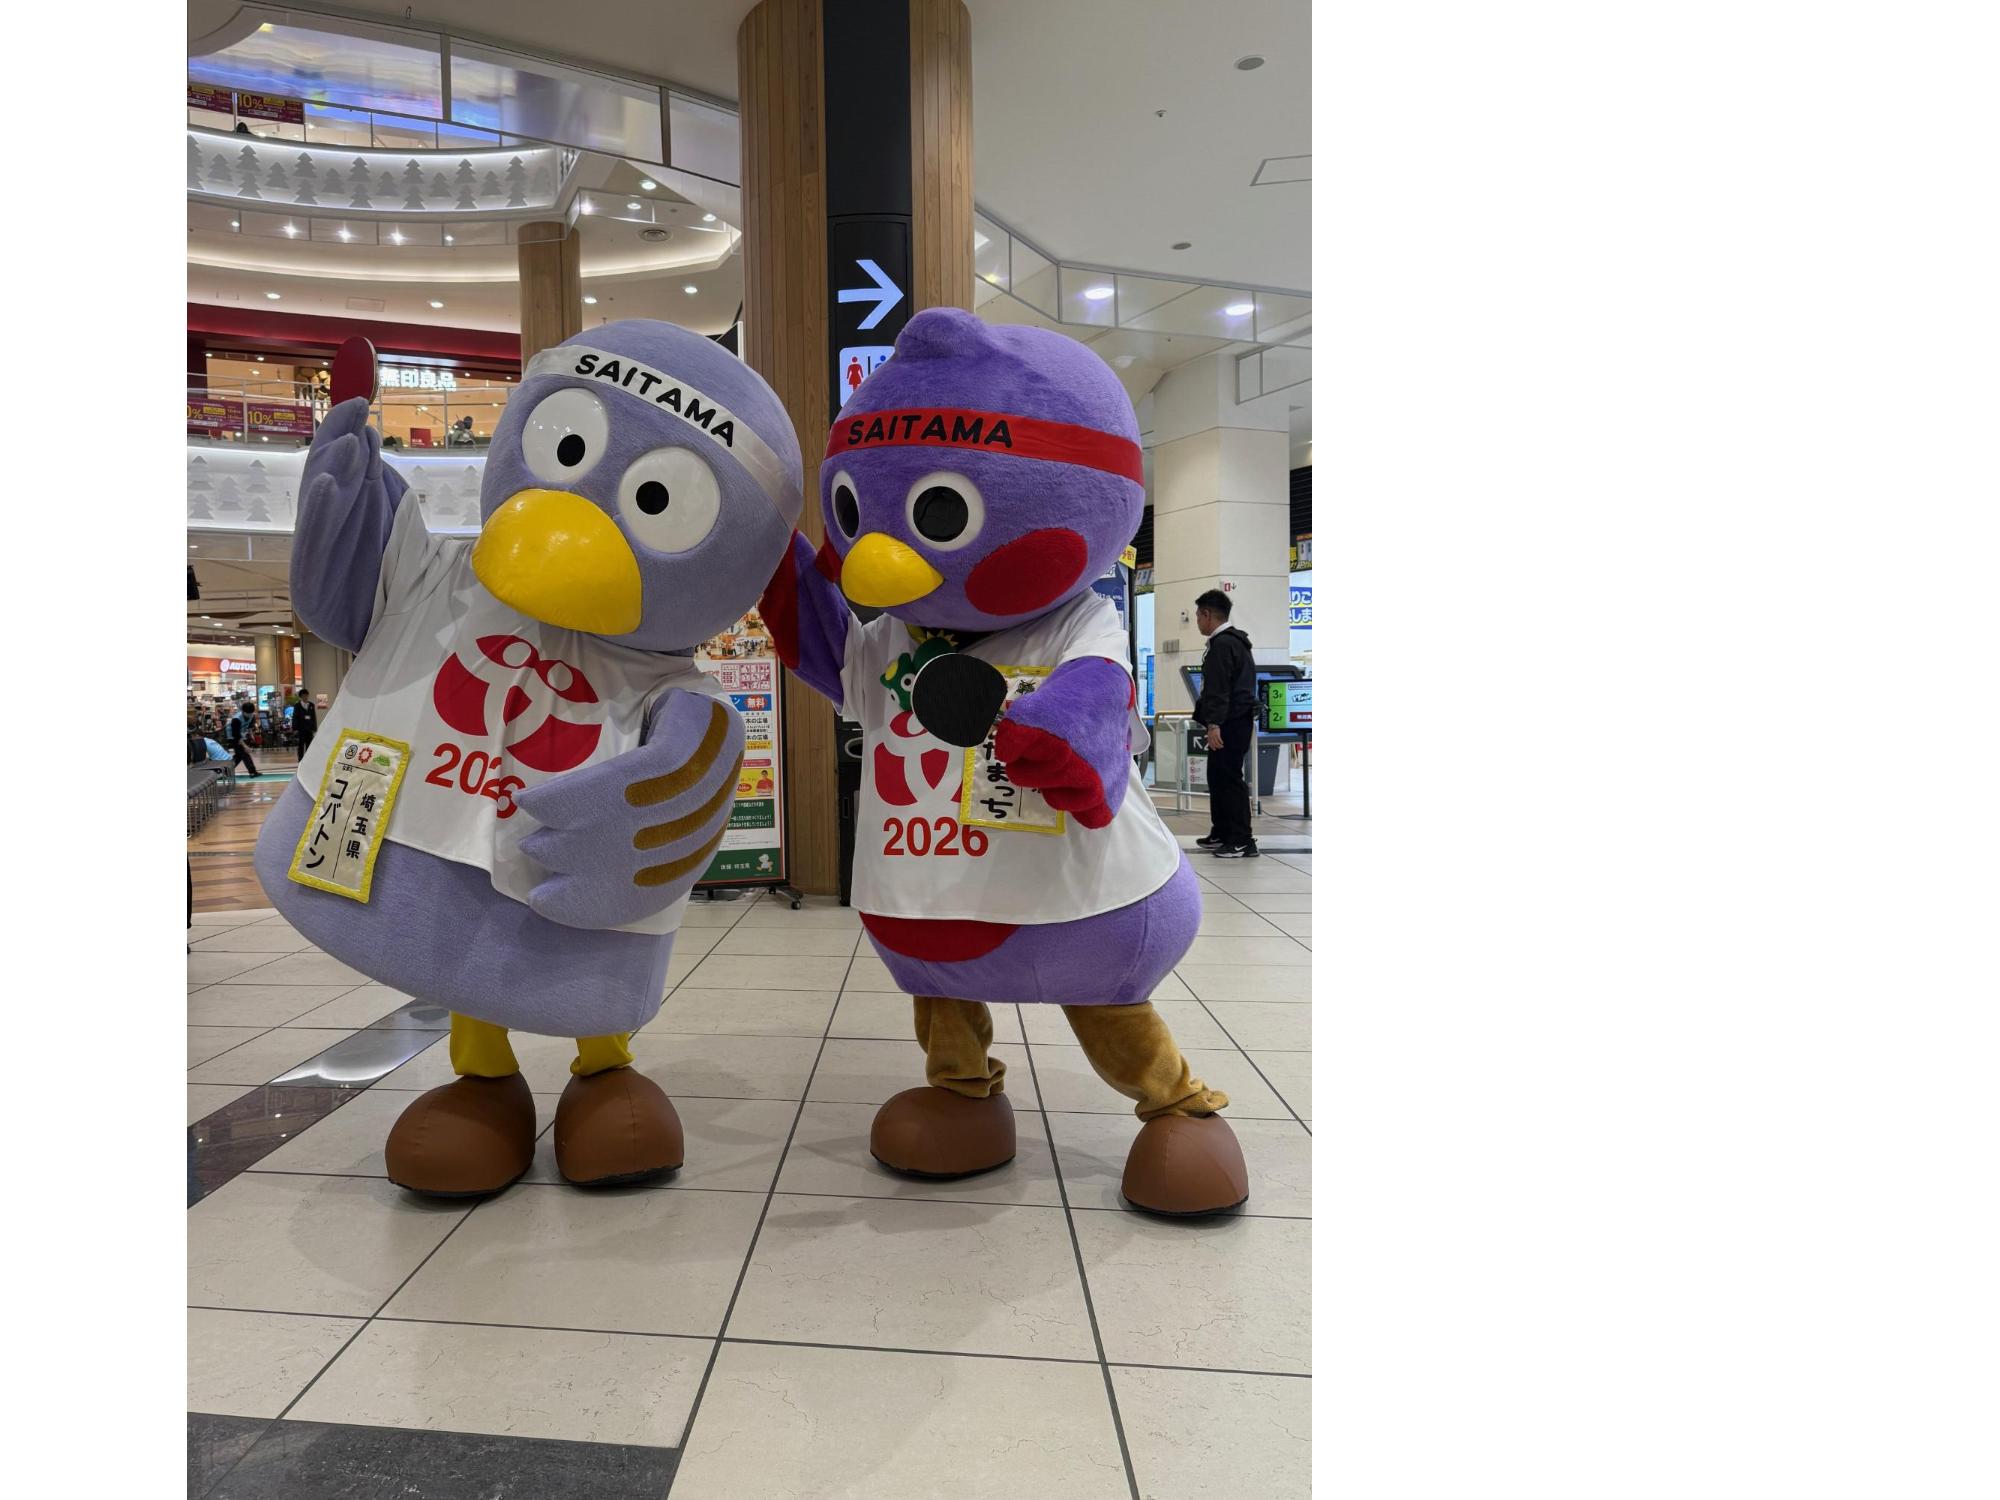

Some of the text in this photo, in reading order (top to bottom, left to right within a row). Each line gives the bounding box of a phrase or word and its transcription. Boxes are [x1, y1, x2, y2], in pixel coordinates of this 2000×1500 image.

[248, 411, 274, 425] 10%
[575, 354, 734, 447] SAITAMA
[848, 415, 1012, 448] SAITAMA
[1290, 591, 1312, 605] りこ
[1290, 608, 1312, 623] しま
[425, 742, 526, 819] 2026
[306, 779, 349, 869] コバトン
[346, 793, 377, 859] 埼玉県
[883, 816, 989, 857] 2026
